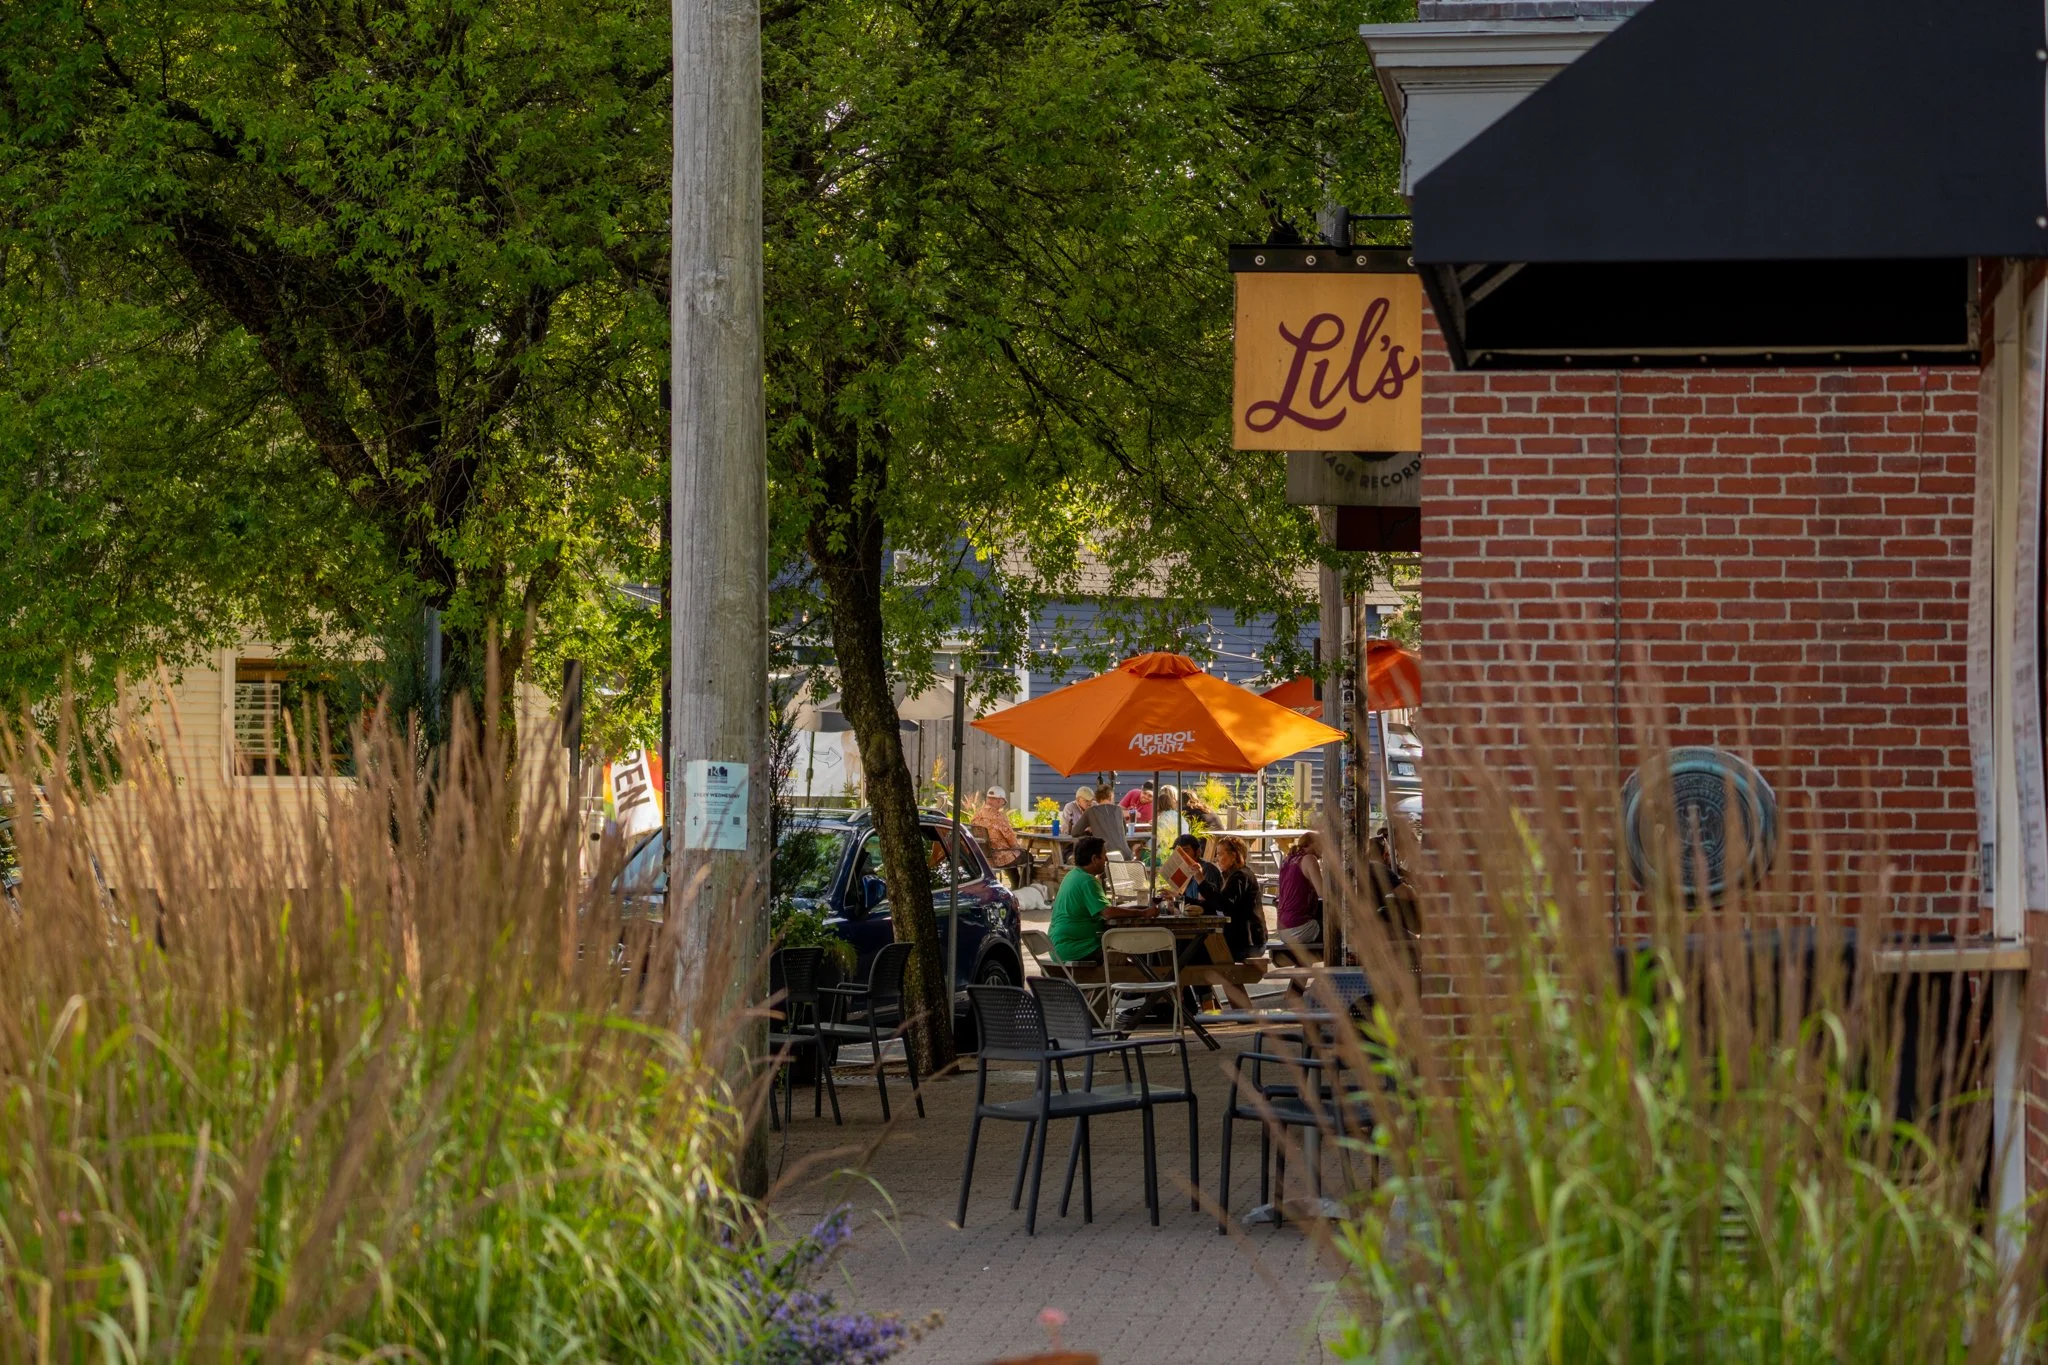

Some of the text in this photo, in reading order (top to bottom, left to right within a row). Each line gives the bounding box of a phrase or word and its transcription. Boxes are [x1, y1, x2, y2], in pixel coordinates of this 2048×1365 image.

[1245, 297, 1420, 433] Lil's
[1323, 452, 1355, 482] AGE
[1128, 730, 1196, 750] APEROL
[1140, 743, 1184, 757] SPRITZ
